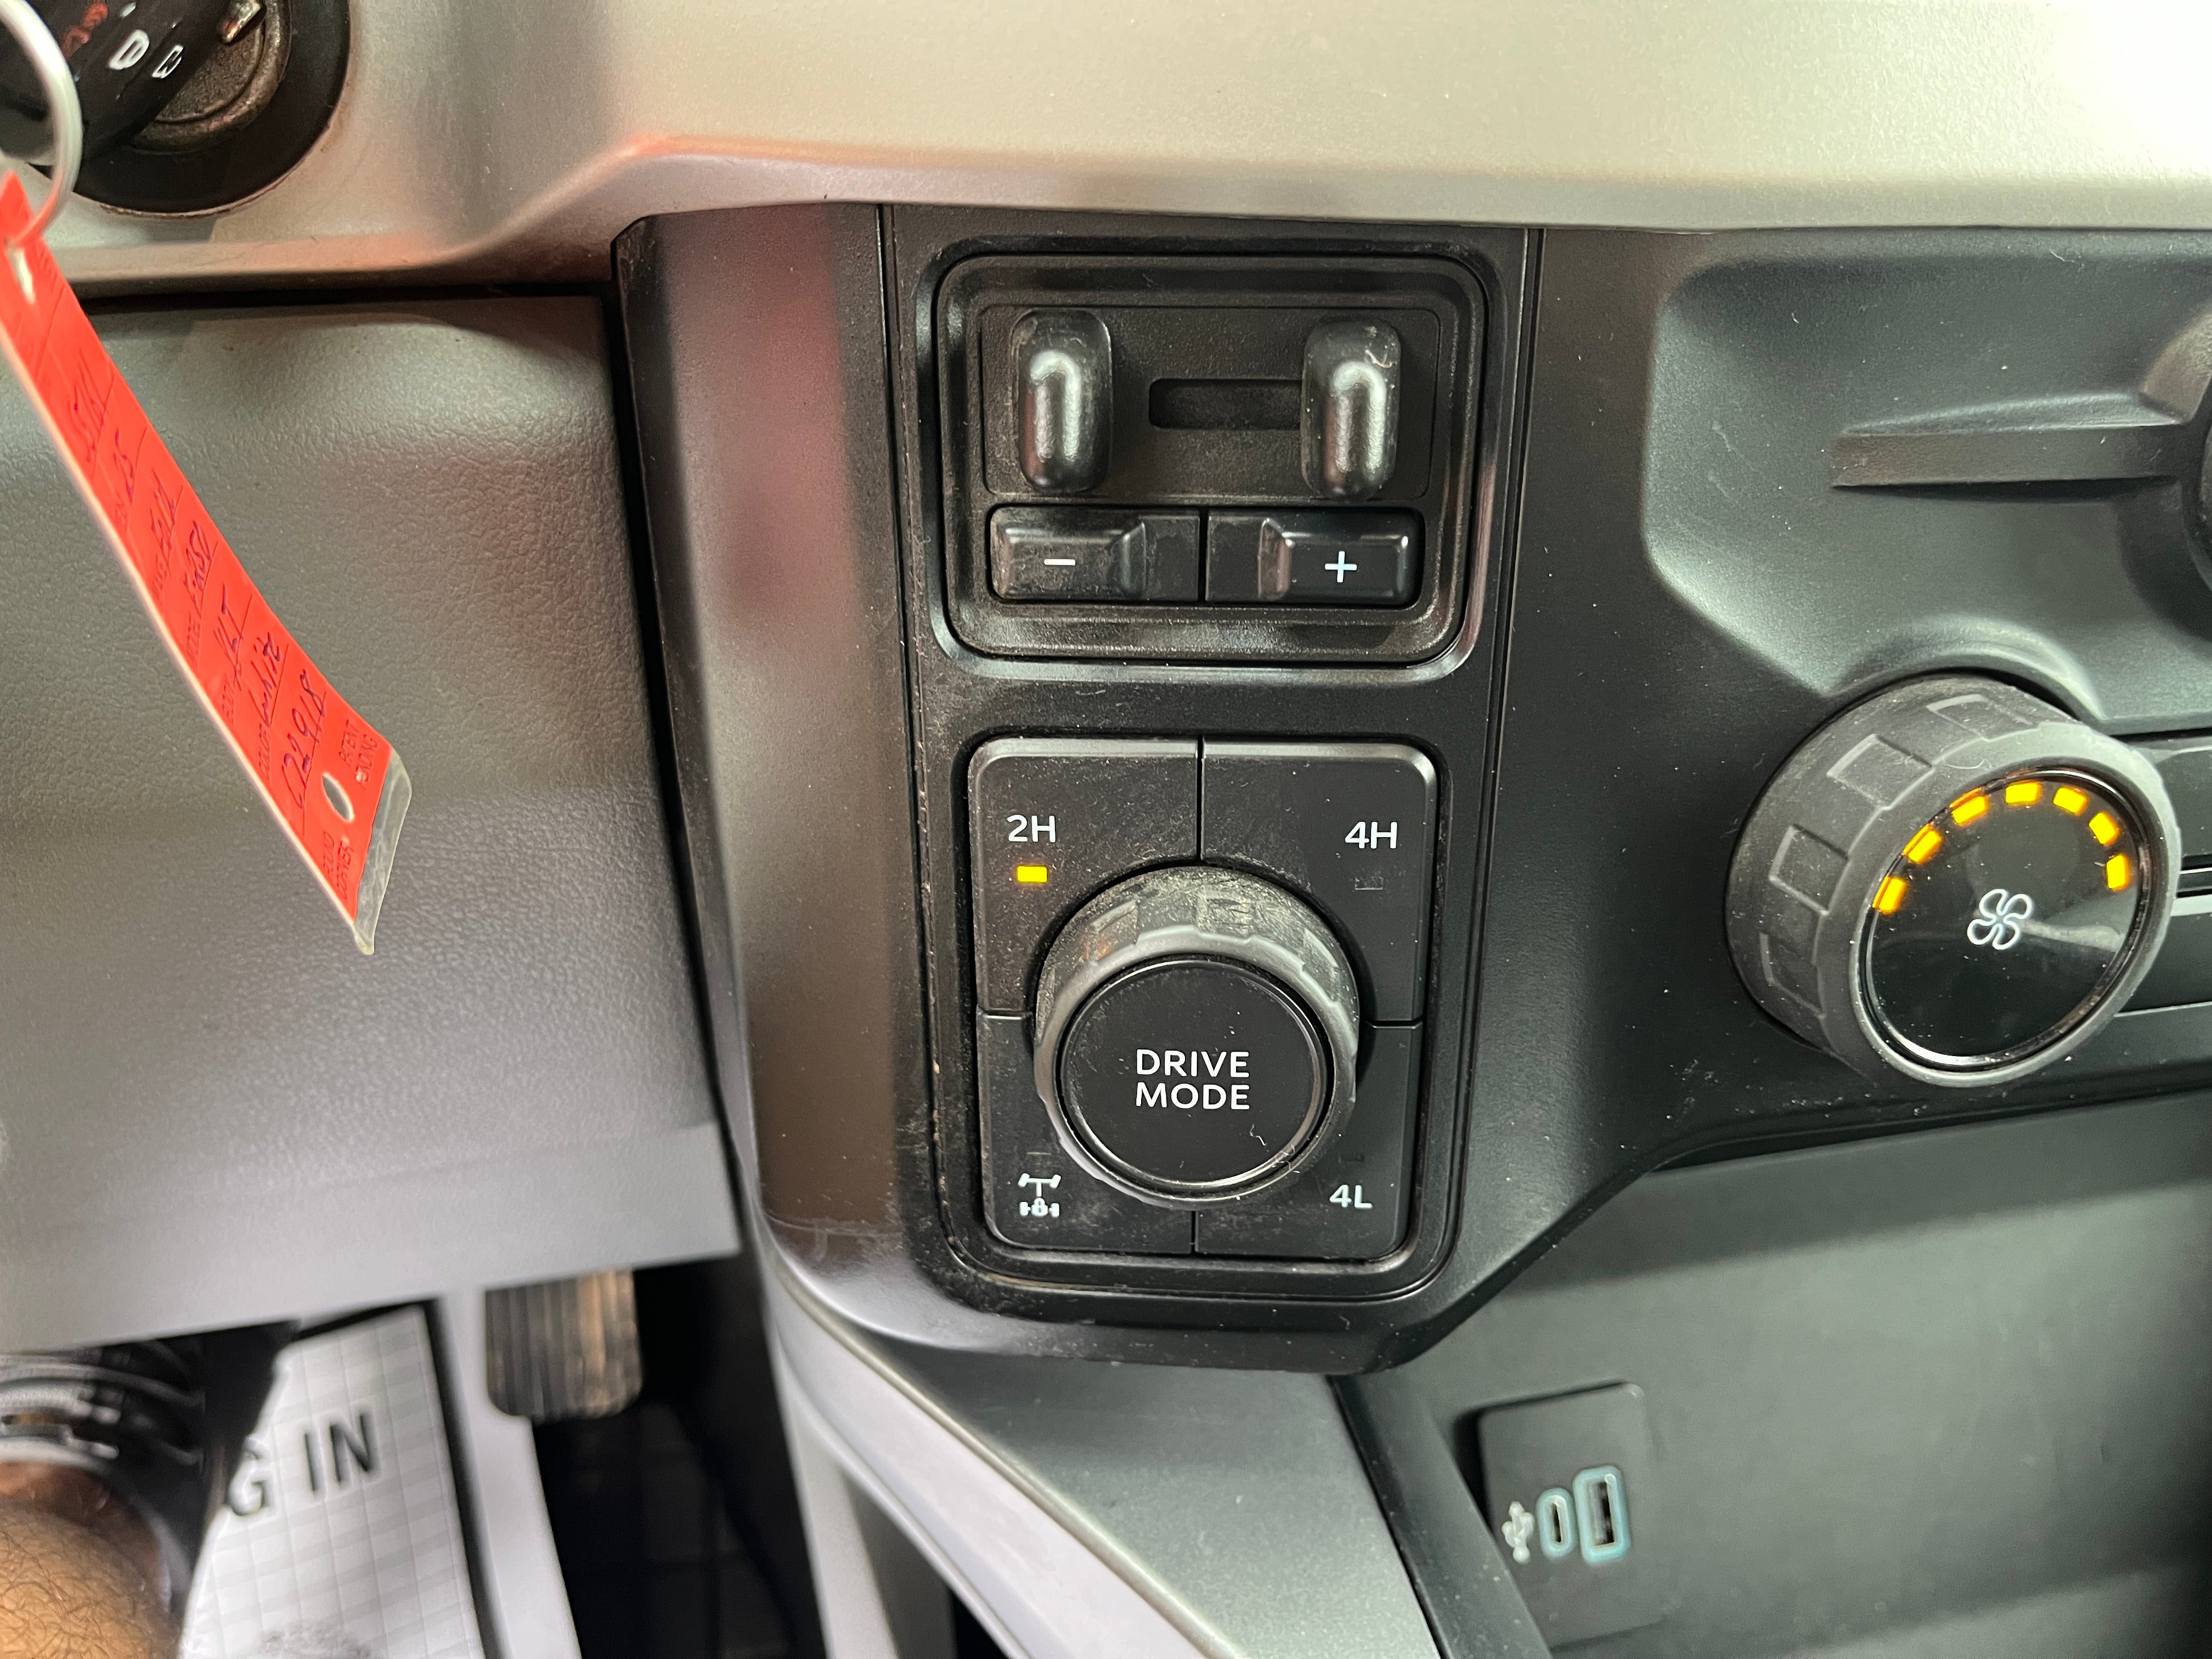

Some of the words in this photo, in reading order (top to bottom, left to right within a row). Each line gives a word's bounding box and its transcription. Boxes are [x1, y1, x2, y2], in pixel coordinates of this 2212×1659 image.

[258, 722, 272, 780] COLOR
[338, 718, 359, 768] PATENT
[354, 732, 378, 791] PENDING
[1007, 814, 1056, 843] 2H
[1345, 821, 1397, 849] 4H
[1136, 1048, 1250, 1078] DRIVE
[1135, 1082, 1250, 1110] MODE
[1329, 1184, 1373, 1209] 4L
[303, 1410, 377, 1493] IN
